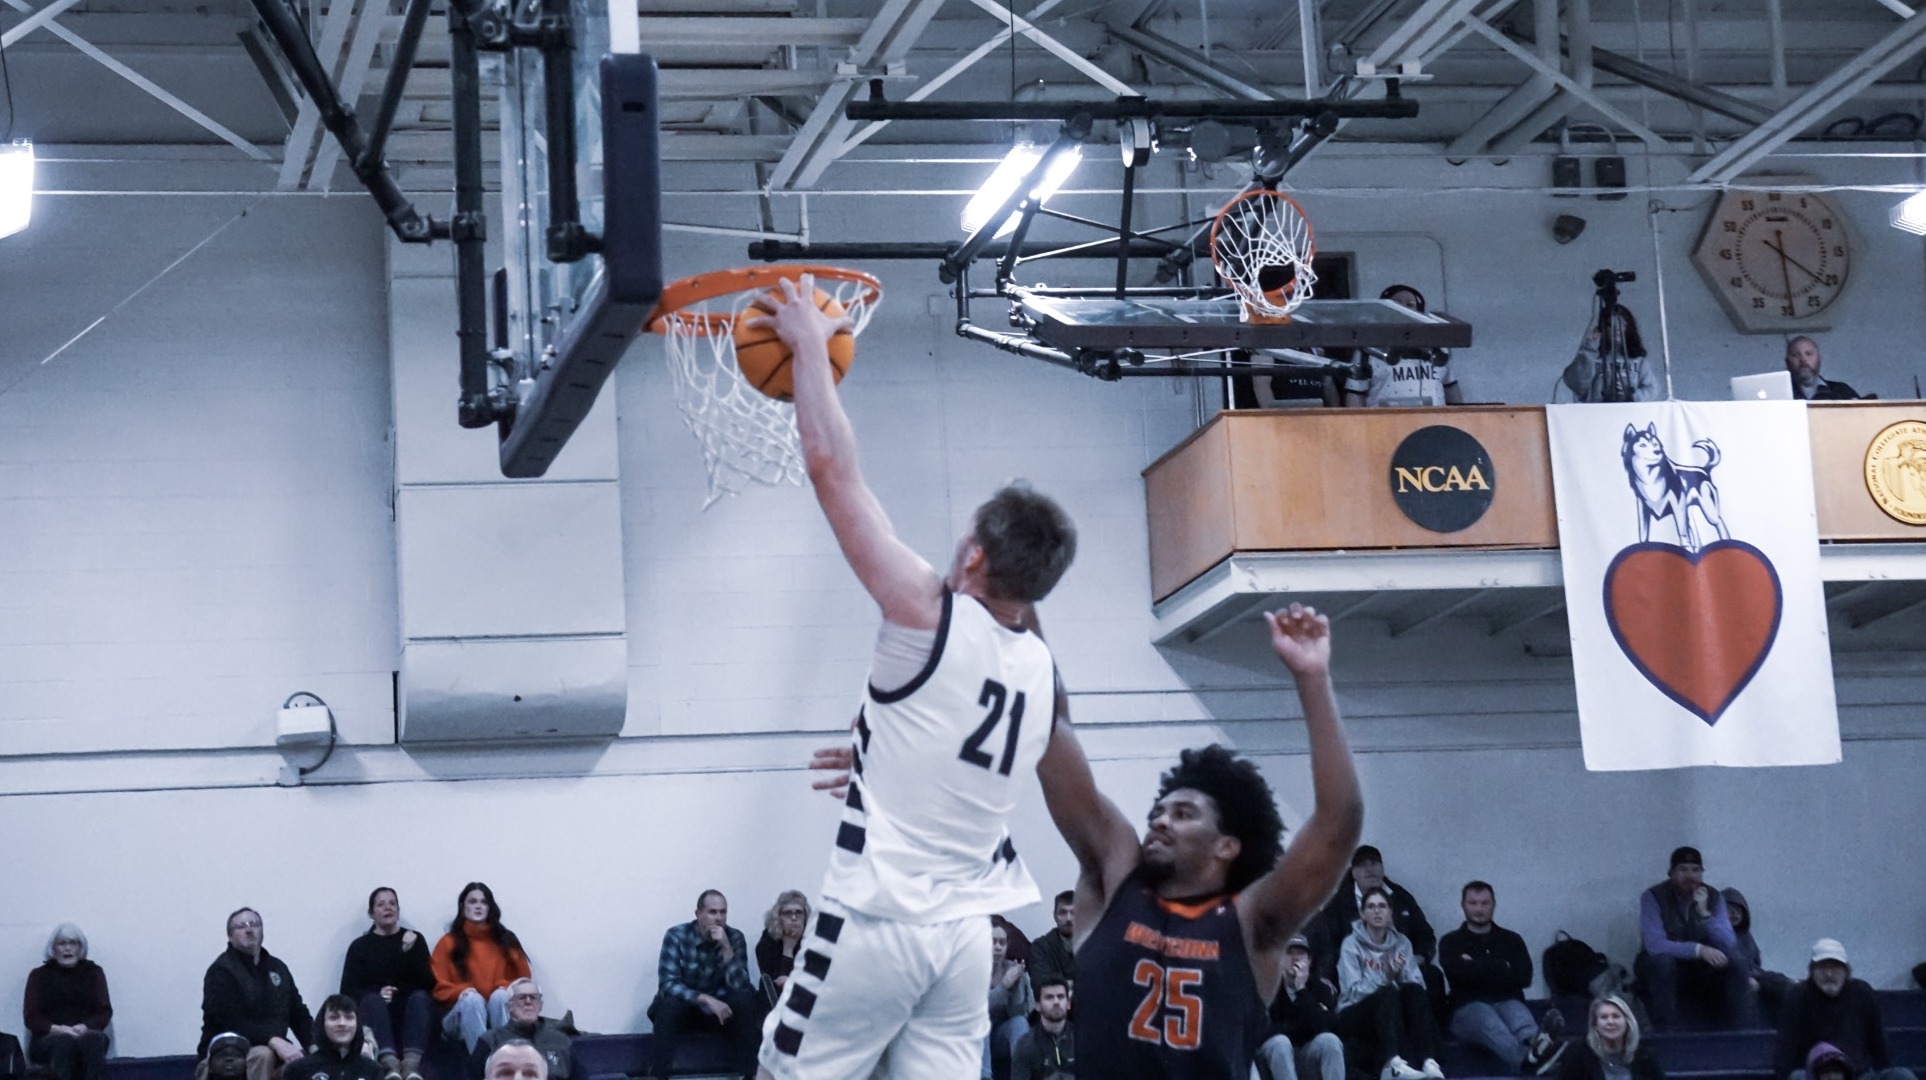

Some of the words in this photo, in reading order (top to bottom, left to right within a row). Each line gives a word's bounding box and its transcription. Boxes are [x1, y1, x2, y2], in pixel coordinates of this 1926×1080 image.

[1742, 200, 1754, 211] 55
[1800, 199, 1808, 208] 5
[1724, 221, 1736, 232] 50
[1822, 219, 1832, 230] 10
[1719, 249, 1732, 260] 45
[1833, 246, 1843, 257] 15
[1730, 277, 1743, 288] 40
[1753, 298, 1765, 309] 35
[1808, 296, 1820, 308] 25
[1391, 365, 1438, 383] MAINE
[1394, 464, 1491, 493] NCAA
[957, 677, 1025, 778] 21
[1128, 957, 1203, 1050] 25
